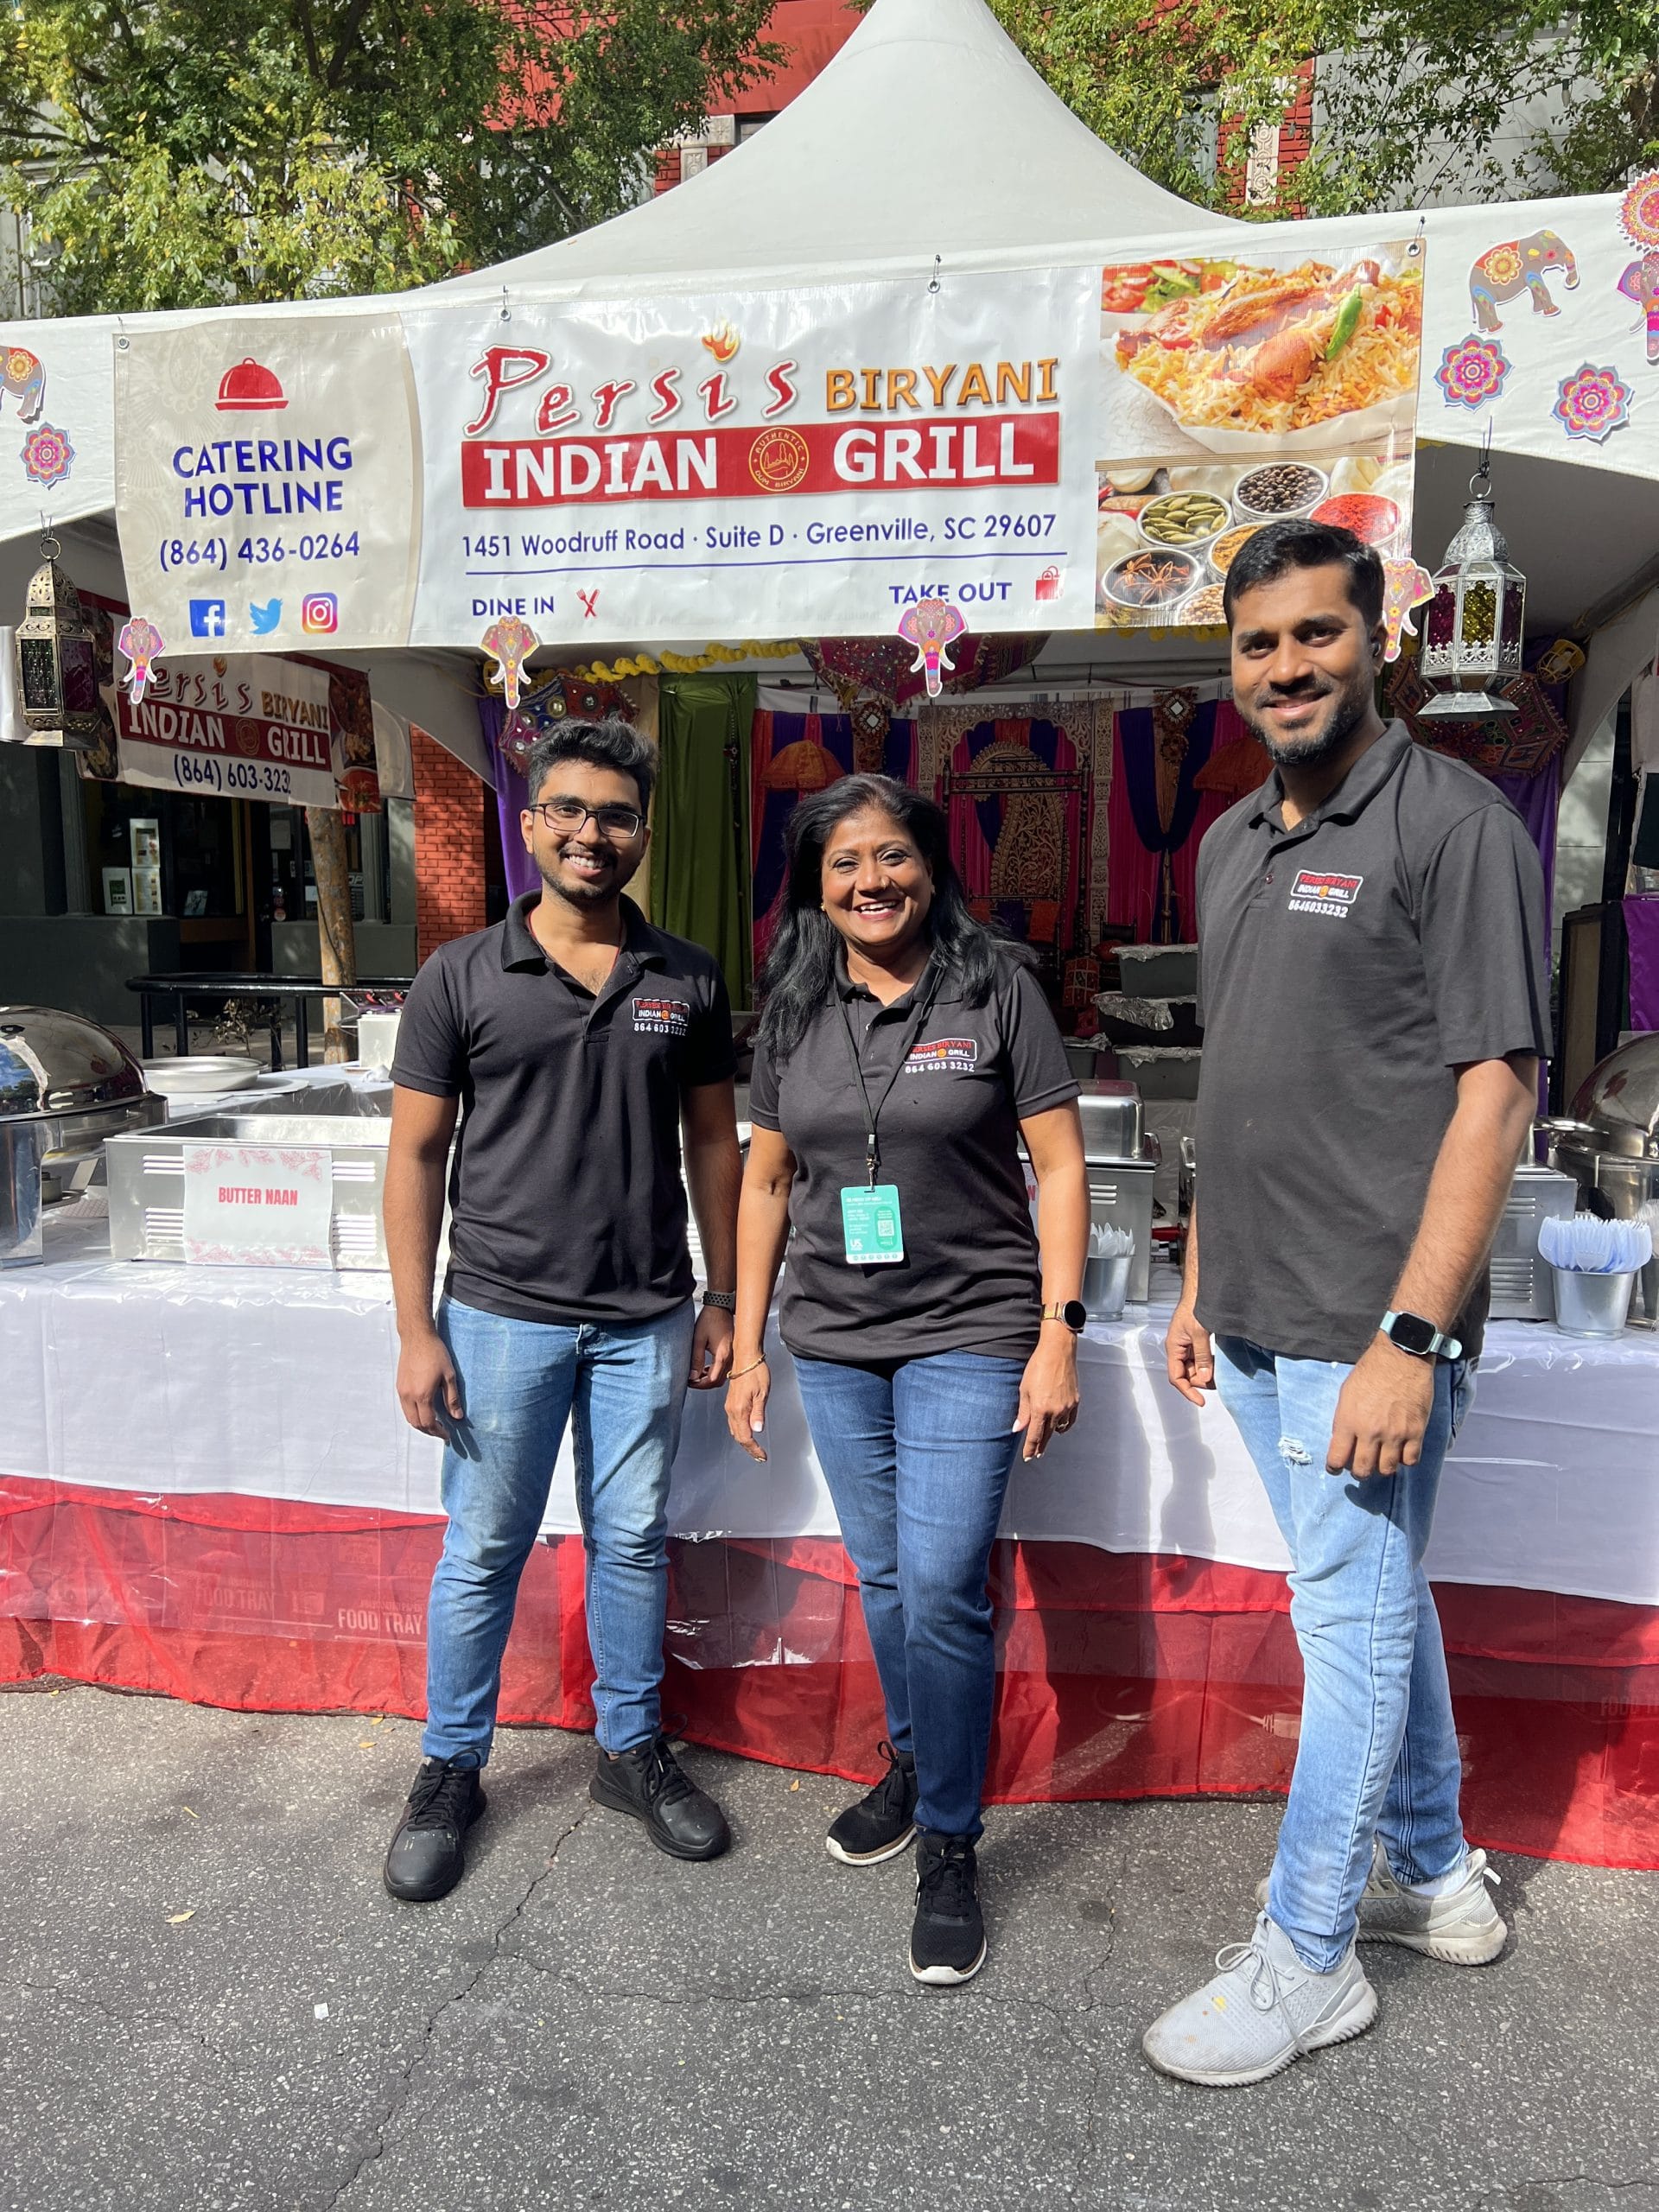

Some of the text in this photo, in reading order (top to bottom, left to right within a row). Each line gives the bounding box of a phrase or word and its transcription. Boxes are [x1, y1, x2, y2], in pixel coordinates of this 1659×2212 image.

[464, 344, 1059, 436] Persis BIRYANI
[173, 436, 353, 478] CATERING
[755, 432, 804, 454] AUTHENTIC
[484, 423, 1034, 499] INDIAN GRILL
[775, 468, 804, 488] BIRYANI
[184, 480, 343, 518] HOTLINE
[160, 531, 359, 572] (864) 436-0264
[462, 514, 1057, 557] 1451 Woodruff Road Suite D Greenville, SC 29607
[472, 596, 555, 616] DINE IN
[888, 582, 1013, 604] TAKE OUT
[118, 660, 328, 730] ersis BIRYANI
[128, 698, 226, 749] INDIAN
[268, 726, 326, 765] GRILL
[175, 754, 221, 791] (864)
[634, 1023, 652, 1032] 864
[905, 1061, 975, 1073] 864 603 3232
[910, 1051, 937, 1060] INDIAN
[219, 1186, 297, 1205] BUTTER NAAN
[338, 1608, 423, 1635] FOOD TRAY
